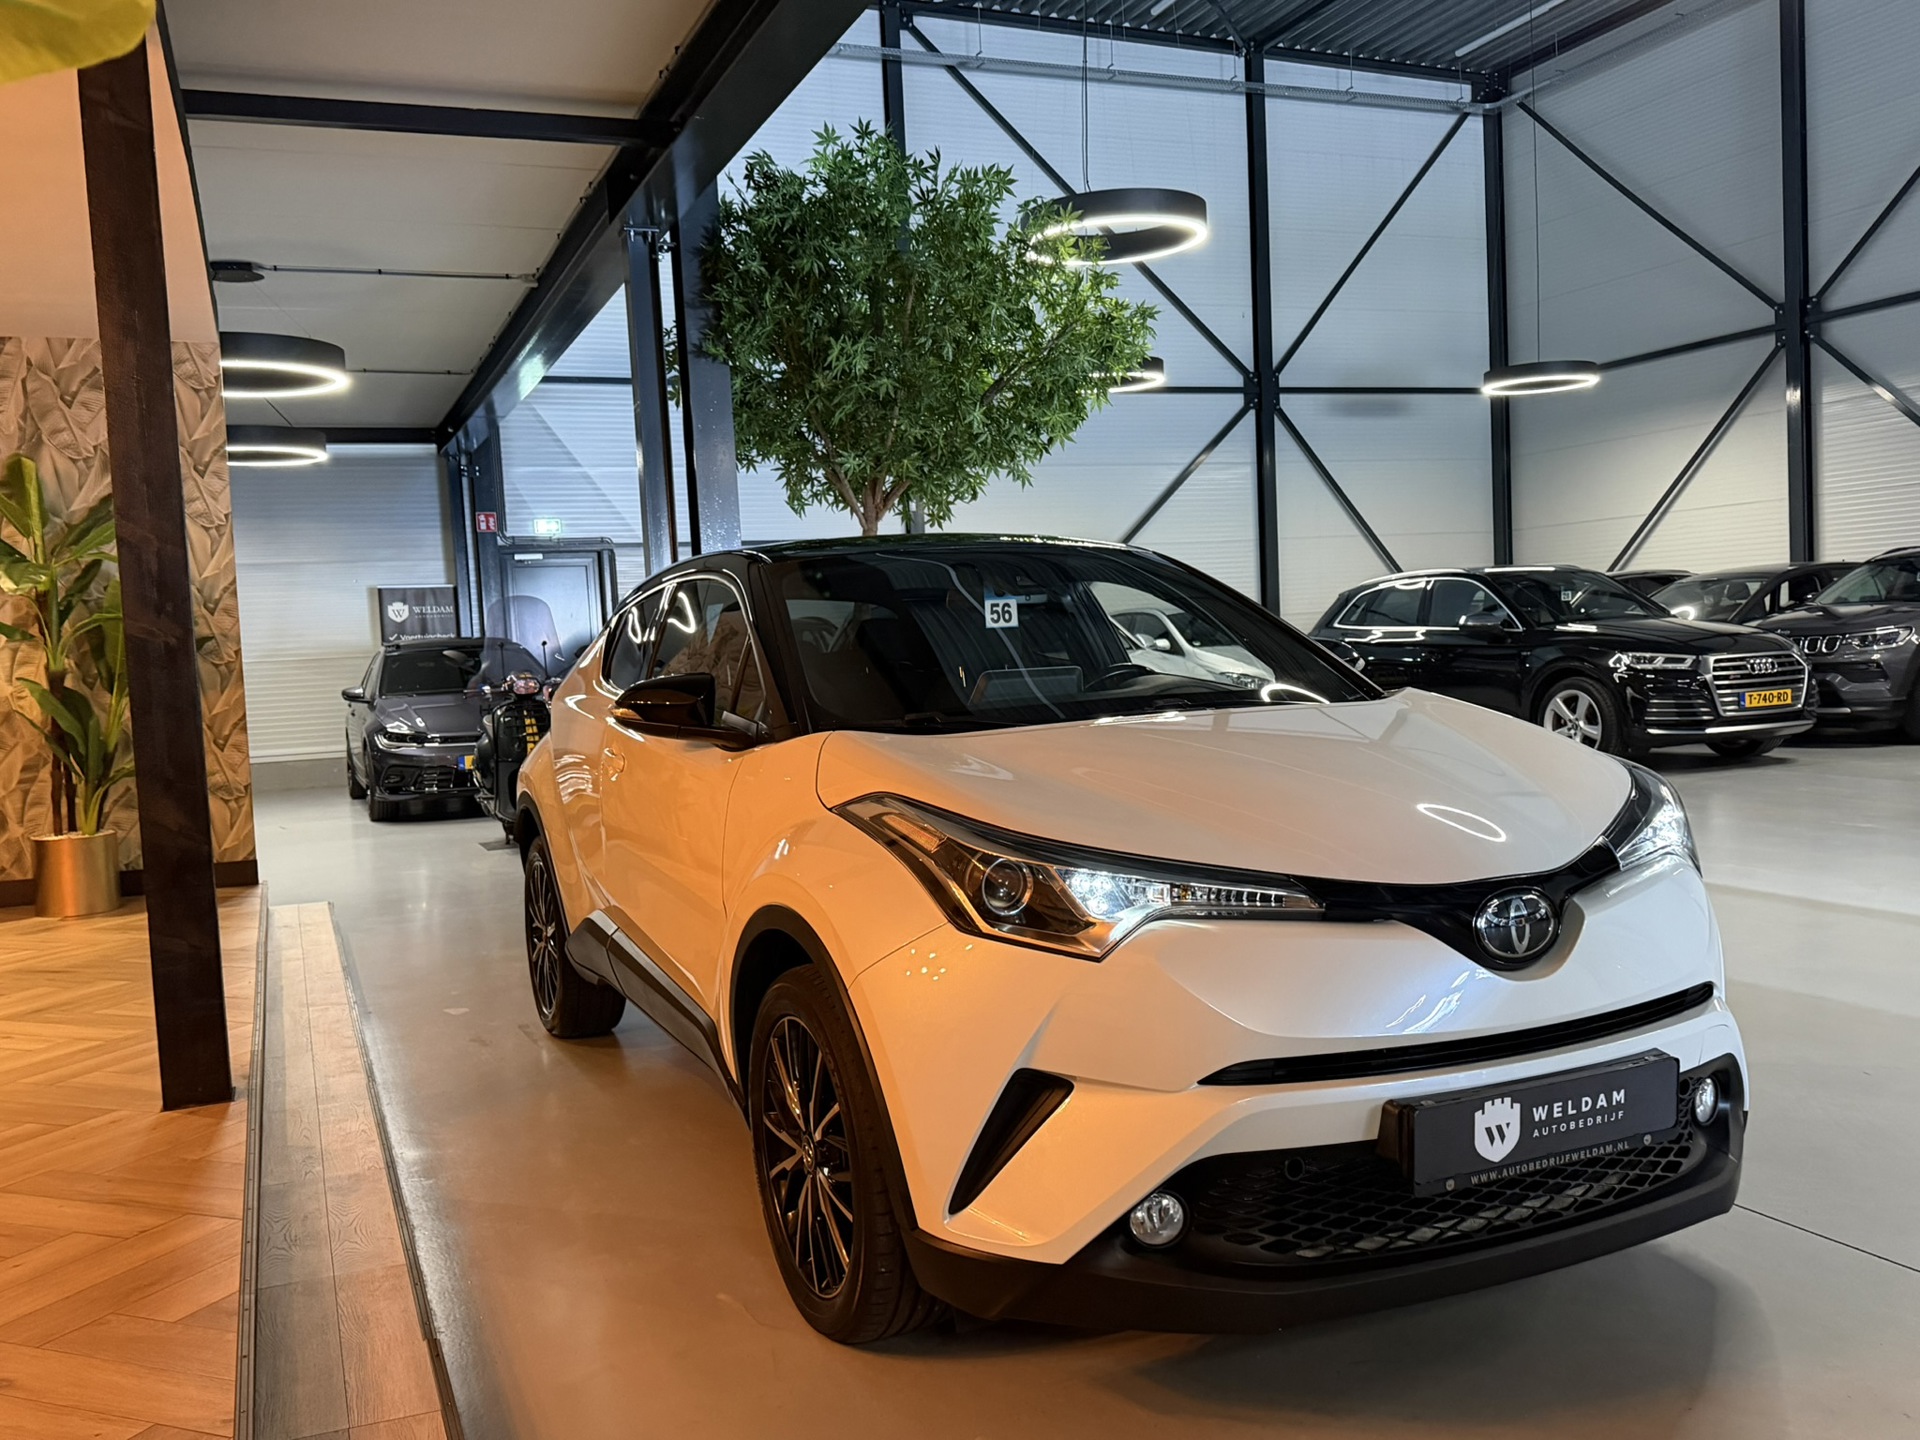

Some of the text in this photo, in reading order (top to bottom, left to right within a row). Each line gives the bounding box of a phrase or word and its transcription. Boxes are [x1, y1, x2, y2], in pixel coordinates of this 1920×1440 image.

[412, 605, 454, 614] WELDAM
[990, 603, 1012, 624] 56
[1748, 691, 1789, 705] T-740-RD
[1532, 1088, 1626, 1122] WELDAM
[1532, 1110, 1625, 1138] AUTOBEDRIJF
[1470, 1140, 1630, 1185] WWW.AUTOBEDRIJFWELDAM.NL
